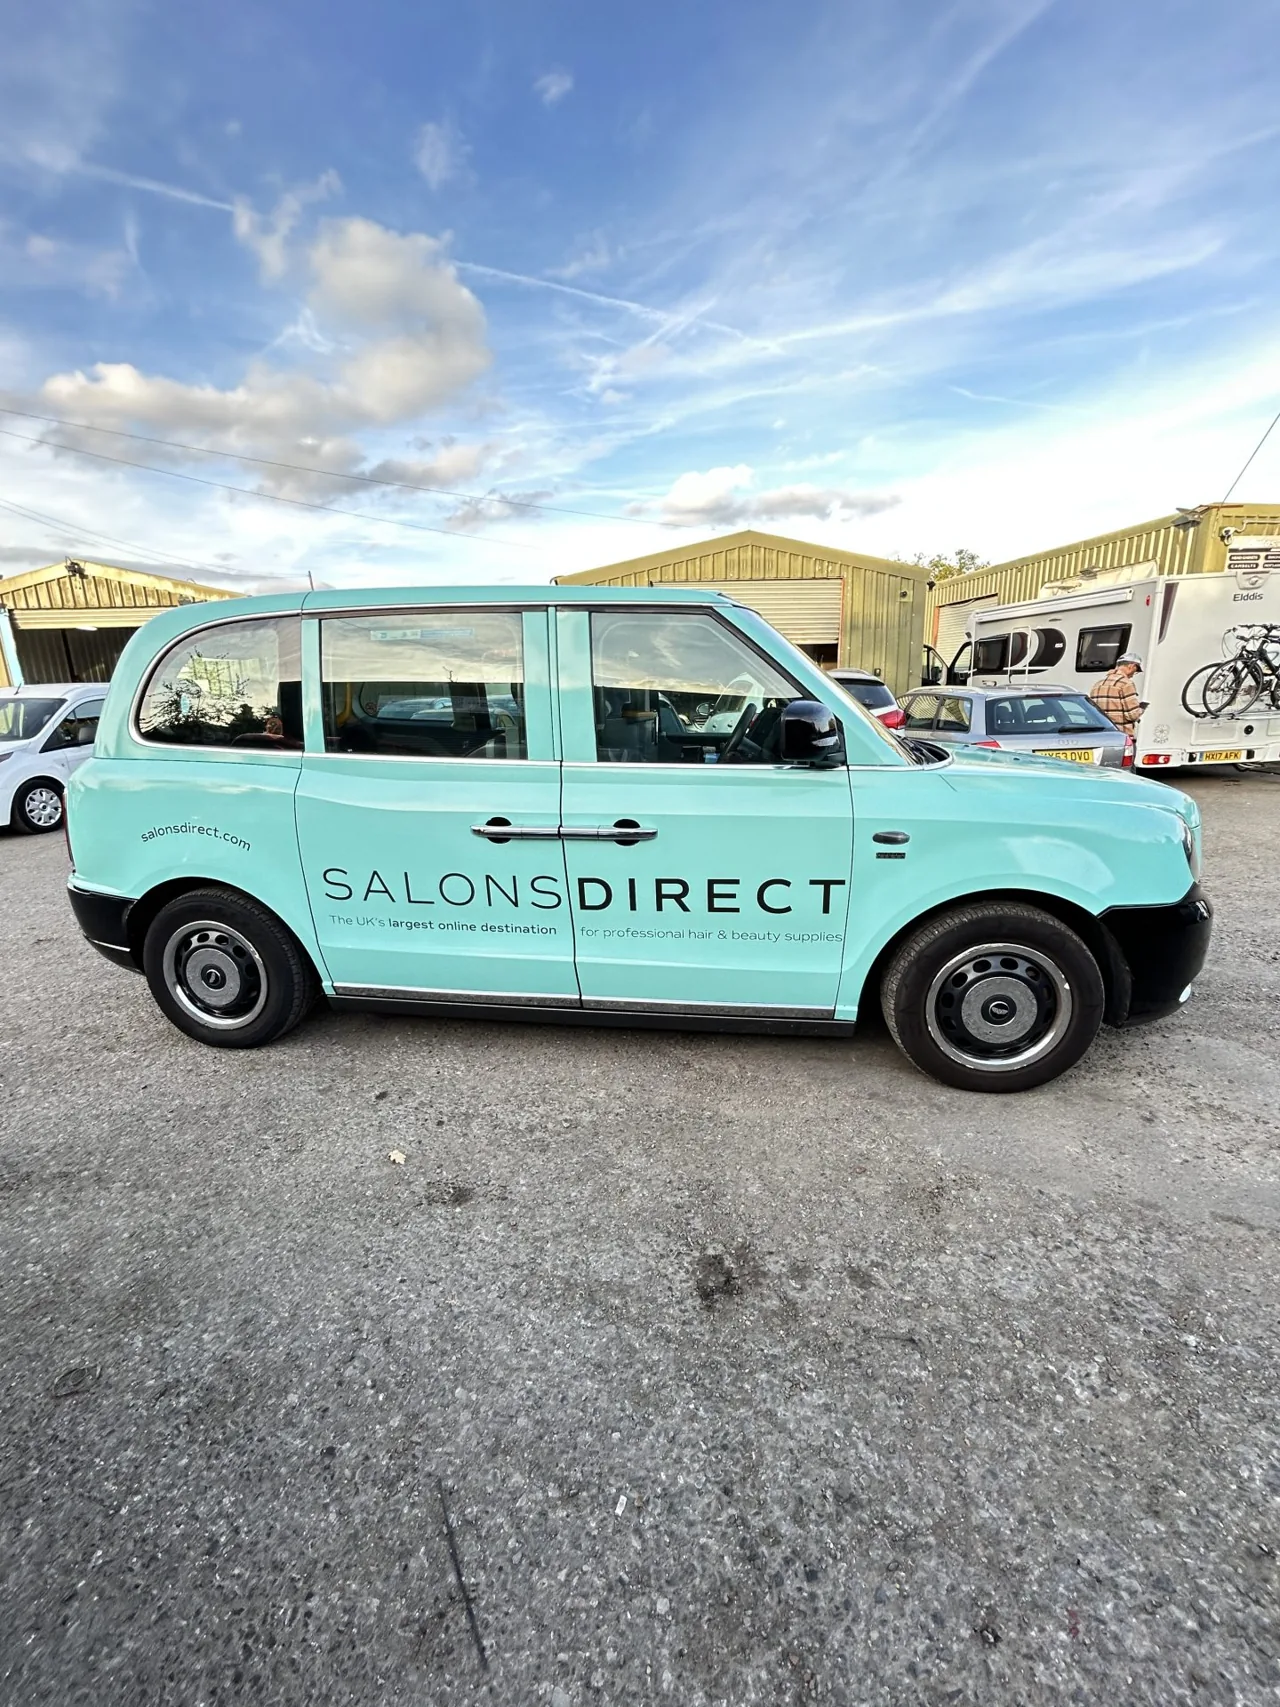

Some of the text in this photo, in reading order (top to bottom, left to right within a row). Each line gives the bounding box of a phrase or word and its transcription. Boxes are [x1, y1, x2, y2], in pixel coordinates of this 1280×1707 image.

[1233, 593, 1264, 601] Elddis
[1070, 751, 1090, 761] OVO
[1205, 751, 1239, 761] HX17 AFK
[141, 822, 251, 851] salonsdirect.com
[329, 914, 843, 944] The UK's largest online destination for professional hair & beauty supplies
